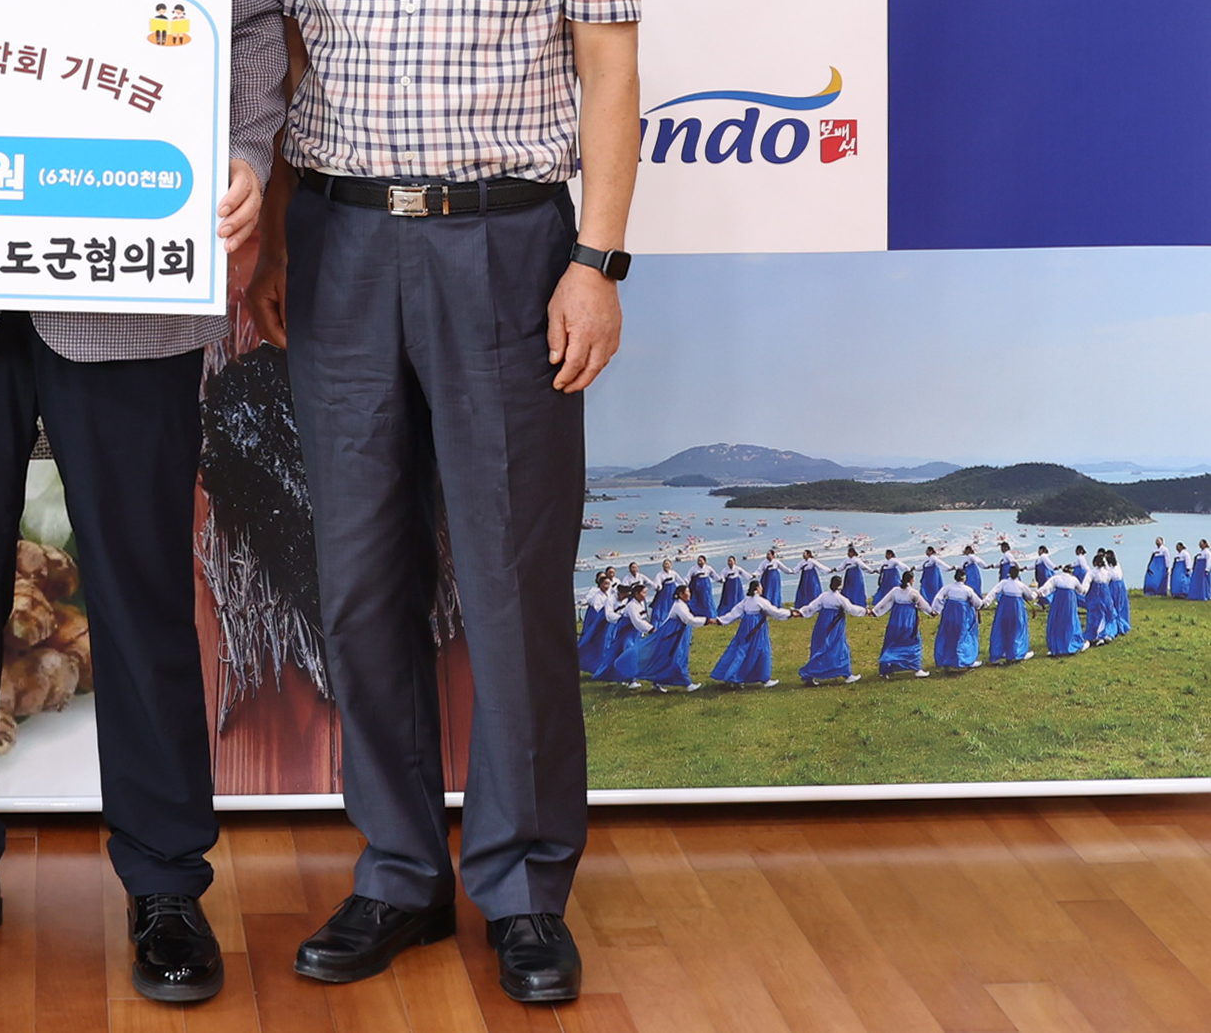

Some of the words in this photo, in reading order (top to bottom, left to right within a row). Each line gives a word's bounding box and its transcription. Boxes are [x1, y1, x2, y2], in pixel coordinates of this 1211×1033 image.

[60, 55, 164, 113] 기탁금
[638, 107, 810, 165] ndo
[38, 167, 183, 190] (6차/6,000천원)
